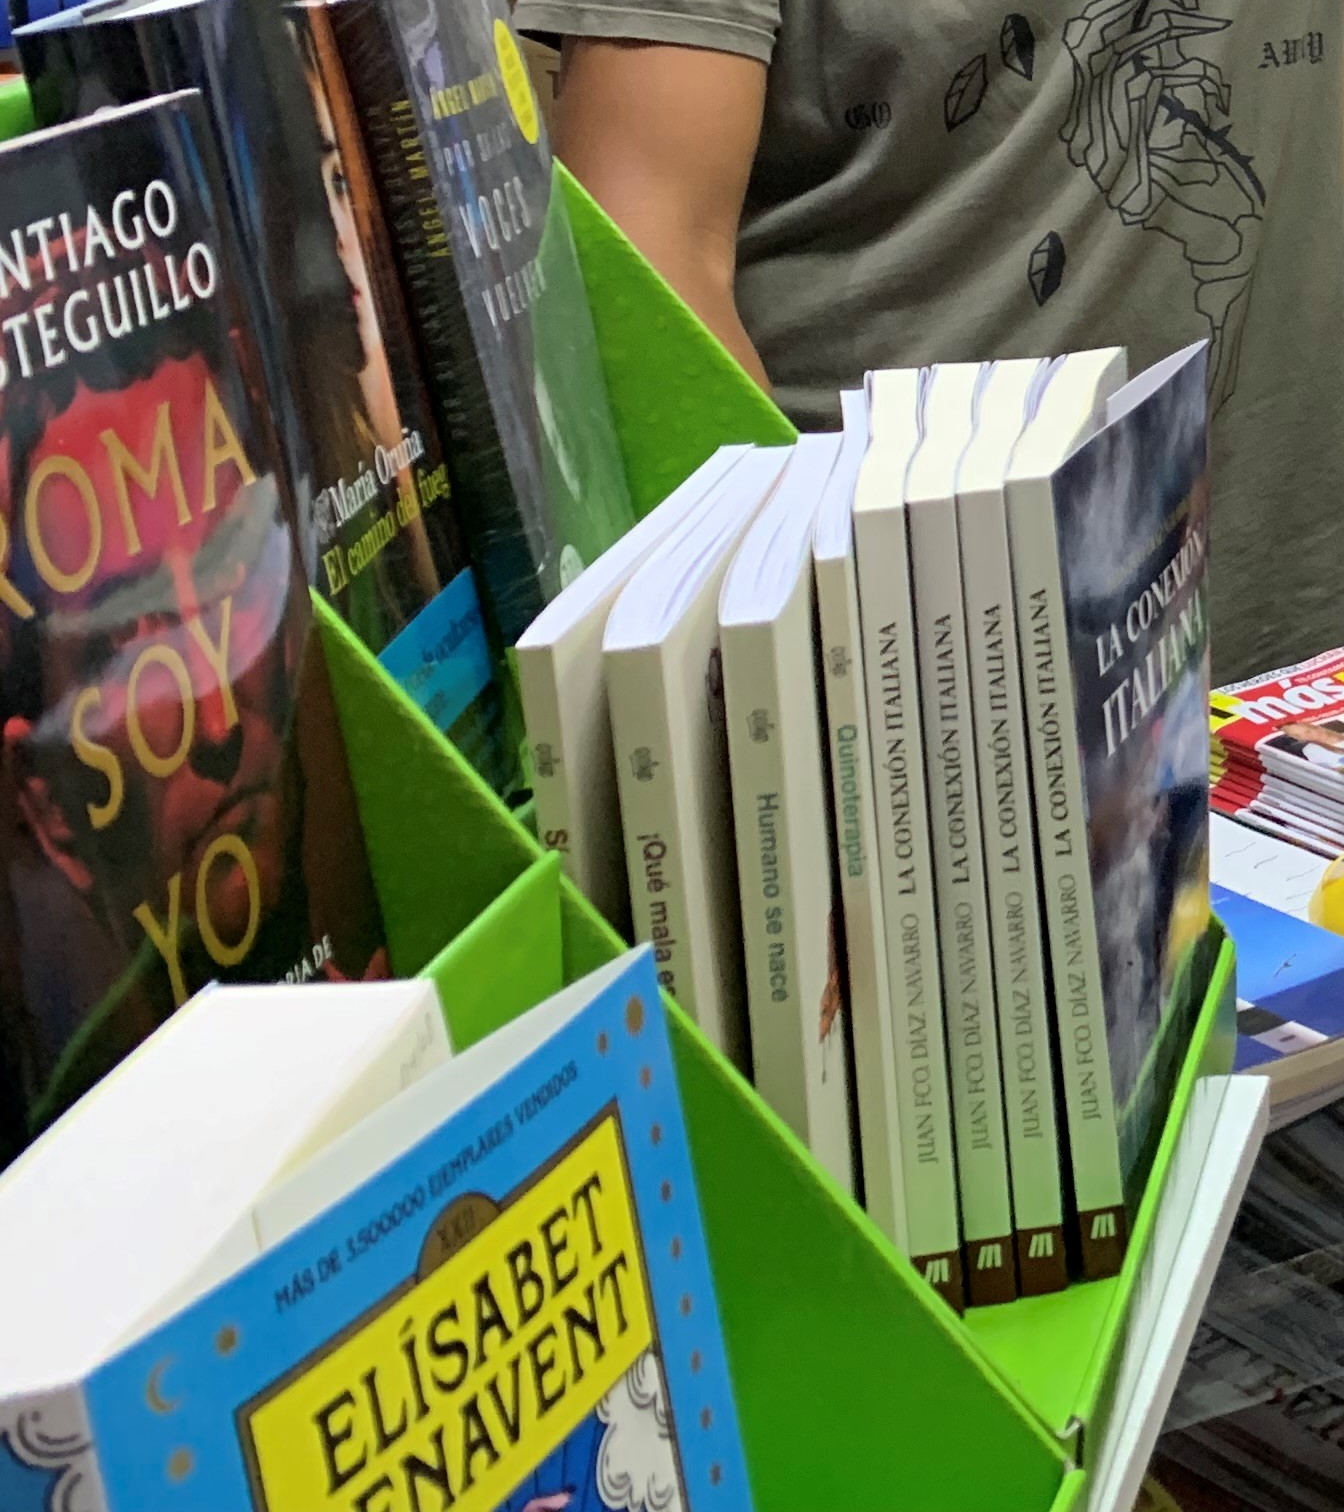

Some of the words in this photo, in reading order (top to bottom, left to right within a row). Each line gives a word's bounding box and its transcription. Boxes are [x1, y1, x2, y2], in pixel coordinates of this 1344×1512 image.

[328, 460, 379, 529] María
[374, 427, 425, 486] Oruña
[322, 544, 349, 597] El
[346, 509, 397, 578] camino
[396, 485, 420, 529] del
[1028, 586, 1055, 708] ITALIANA
[1095, 620, 1123, 677] LA
[1122, 529, 1204, 646] CONEXIÓN
[878, 620, 906, 741] ITALIANA
[933, 613, 957, 728] ITALIANA
[982, 602, 1007, 719] ITALIANA
[1101, 592, 1205, 759] ITALIANA
[69, 597, 240, 830] SOY
[836, 723, 867, 878] Quinoterapia
[887, 744, 916, 862] CONEXIÓN
[939, 731, 968, 854] CONEXIÓN
[989, 723, 1017, 840] CONEXIÓN
[1035, 714, 1070, 826] CONEXIÓN
[636, 832, 671, 894] ¡Qué
[755, 792, 780, 899] Humano
[897, 863, 917, 897] LA
[951, 855, 971, 886] LA
[1000, 841, 1021, 875] LA
[1052, 827, 1074, 858] LA
[133, 834, 262, 1008] YO
[650, 899, 678, 965] mala
[763, 905, 784, 936] se
[899, 912, 924, 998] NAVARRO
[952, 901, 978, 991] NAVARRO
[1003, 890, 1029, 980] NAVARRO
[1056, 873, 1083, 964] NAVARRO
[905, 1007, 931, 1060] DÍAZ
[959, 993, 984, 1059] DÍAZ
[1010, 984, 1034, 1046] DÍAZ
[1065, 966, 1093, 1031] DÍAZ
[915, 1117, 940, 1165] JUAN
[969, 1108, 993, 1152] JUAN
[1020, 1100, 1045, 1141] JUAN
[1079, 1080, 1103, 1124] JUAN
[274, 1266, 315, 1314] MÁS
[316, 1246, 344, 1284] DE
[426, 1120, 515, 1199] EJEMPLARES
[513, 1059, 580, 1127] VENDIDOS
[312, 1172, 607, 1497] ELÍSABET
